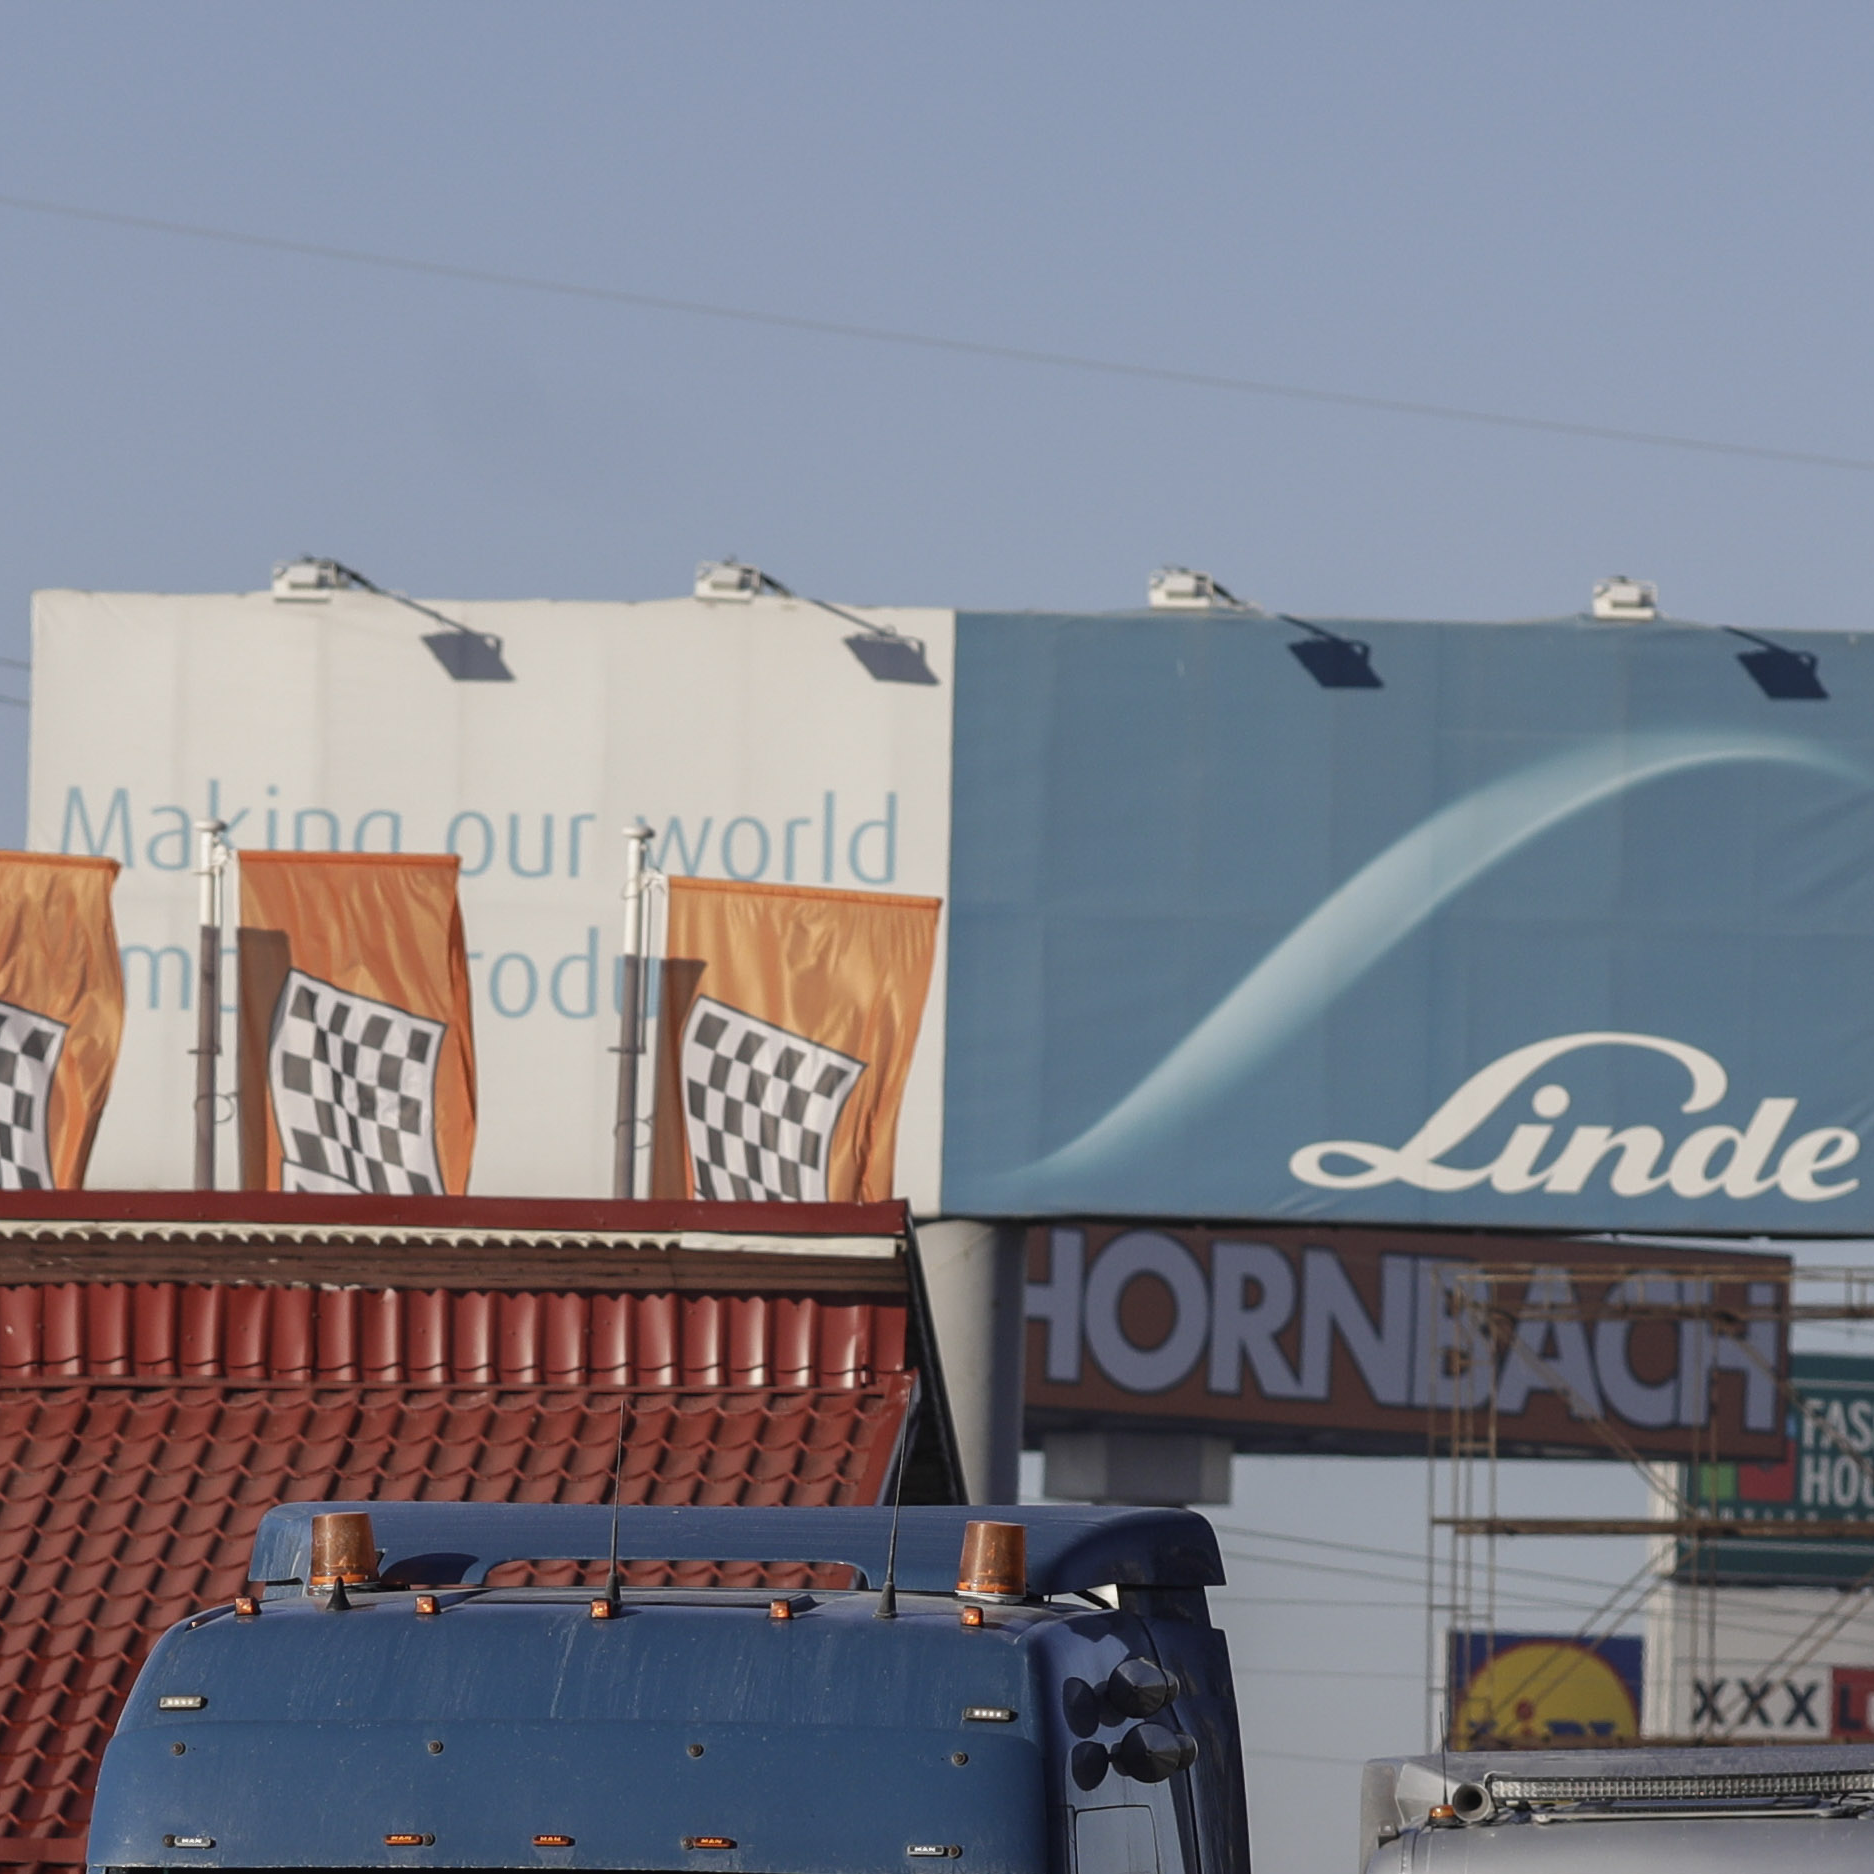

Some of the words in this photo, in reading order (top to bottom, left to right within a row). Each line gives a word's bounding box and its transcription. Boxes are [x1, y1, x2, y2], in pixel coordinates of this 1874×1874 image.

[446, 807, 595, 880] our
[637, 792, 899, 885] world
[1288, 1031, 1861, 1202] Linde
[1692, 1679, 1818, 1728] XXX
